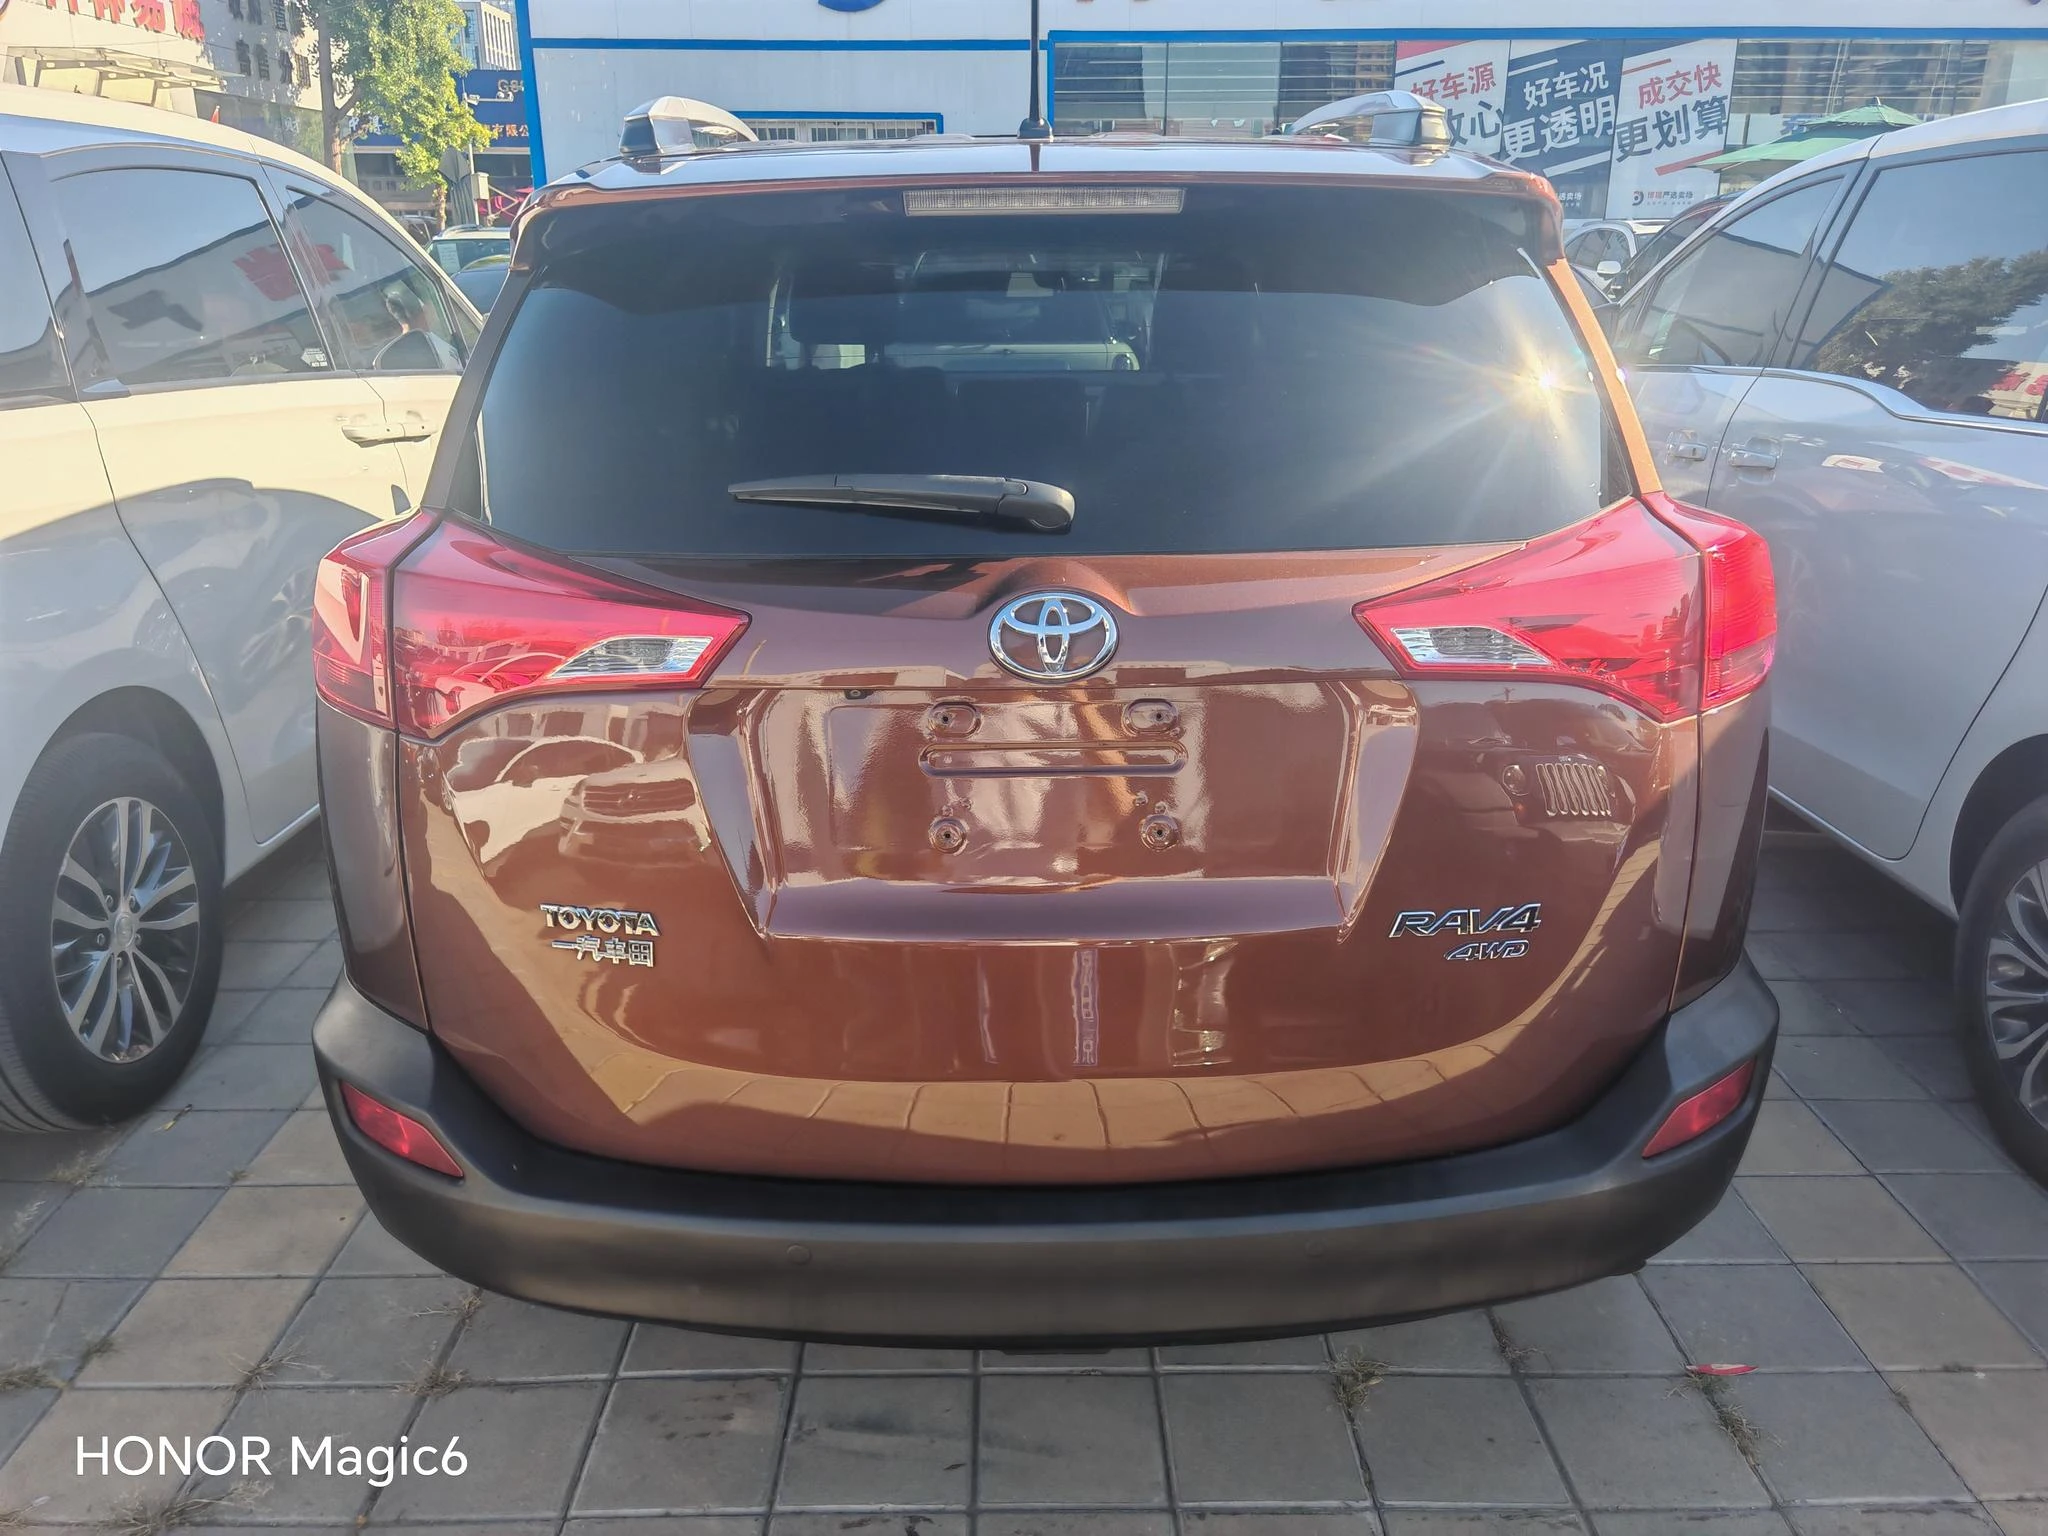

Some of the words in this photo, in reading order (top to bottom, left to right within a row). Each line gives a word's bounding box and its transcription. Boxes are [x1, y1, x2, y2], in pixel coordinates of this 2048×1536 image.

[1410, 62, 1496, 101] 好车源
[1523, 61, 1609, 111] 好车况
[1638, 61, 1722, 110] 成交快
[1503, 94, 1616, 164] 更透明
[1615, 94, 1728, 163] 更划算
[540, 903, 660, 937] TOYOTA
[1389, 902, 1542, 939] RAV4
[1443, 939, 1530, 961] 4WD
